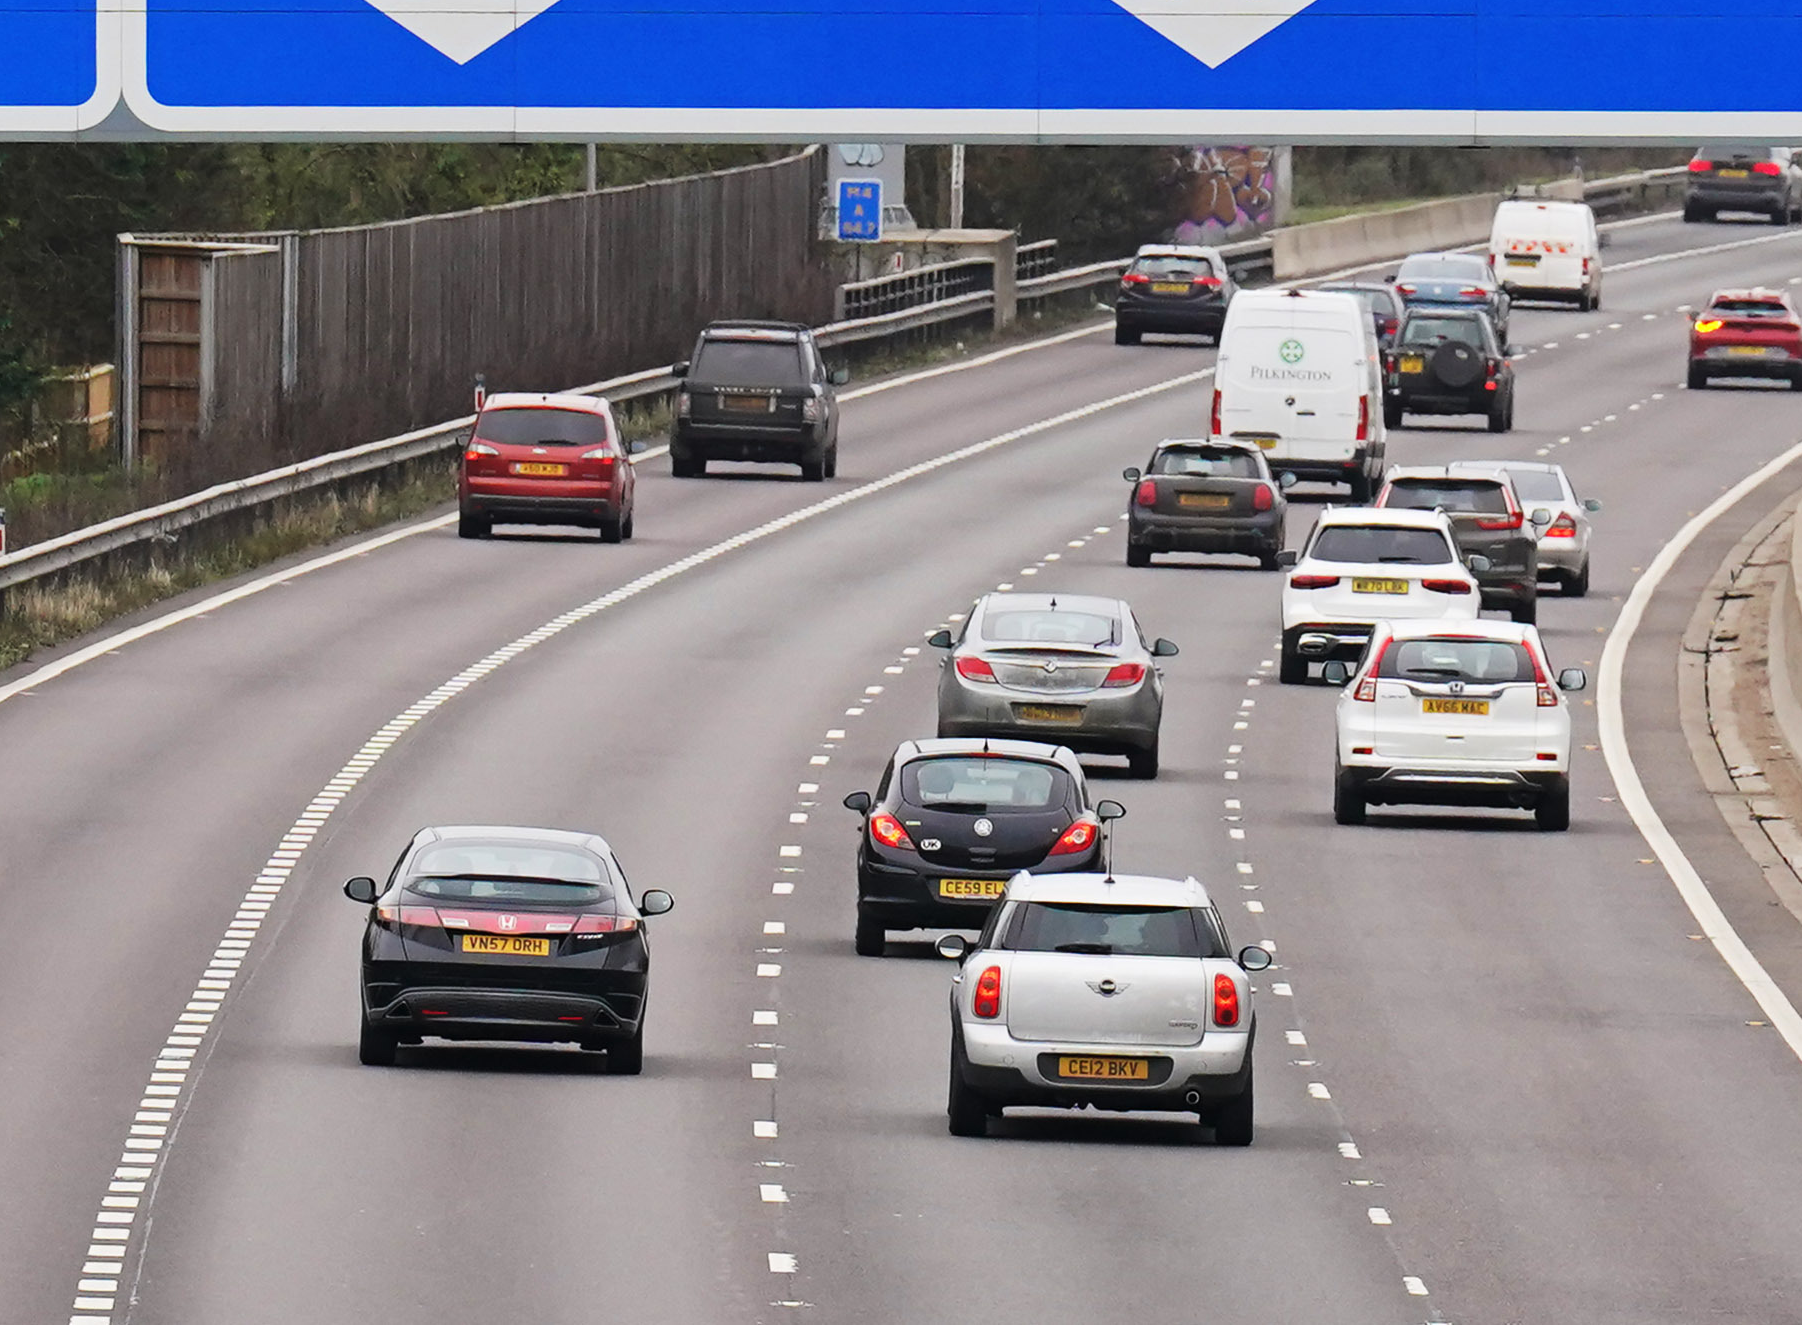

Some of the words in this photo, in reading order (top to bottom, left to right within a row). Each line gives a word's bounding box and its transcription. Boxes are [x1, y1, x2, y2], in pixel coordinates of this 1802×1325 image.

[1250, 365, 1332, 381] PILKINGTON
[923, 840, 939, 849] UK
[945, 881, 981, 894] CE59
[984, 882, 1002, 895] EL
[468, 936, 509, 951] VN57
[512, 939, 543, 953] ORH
[1068, 1059, 1103, 1075] CE12
[1108, 1061, 1139, 1076] BKV
